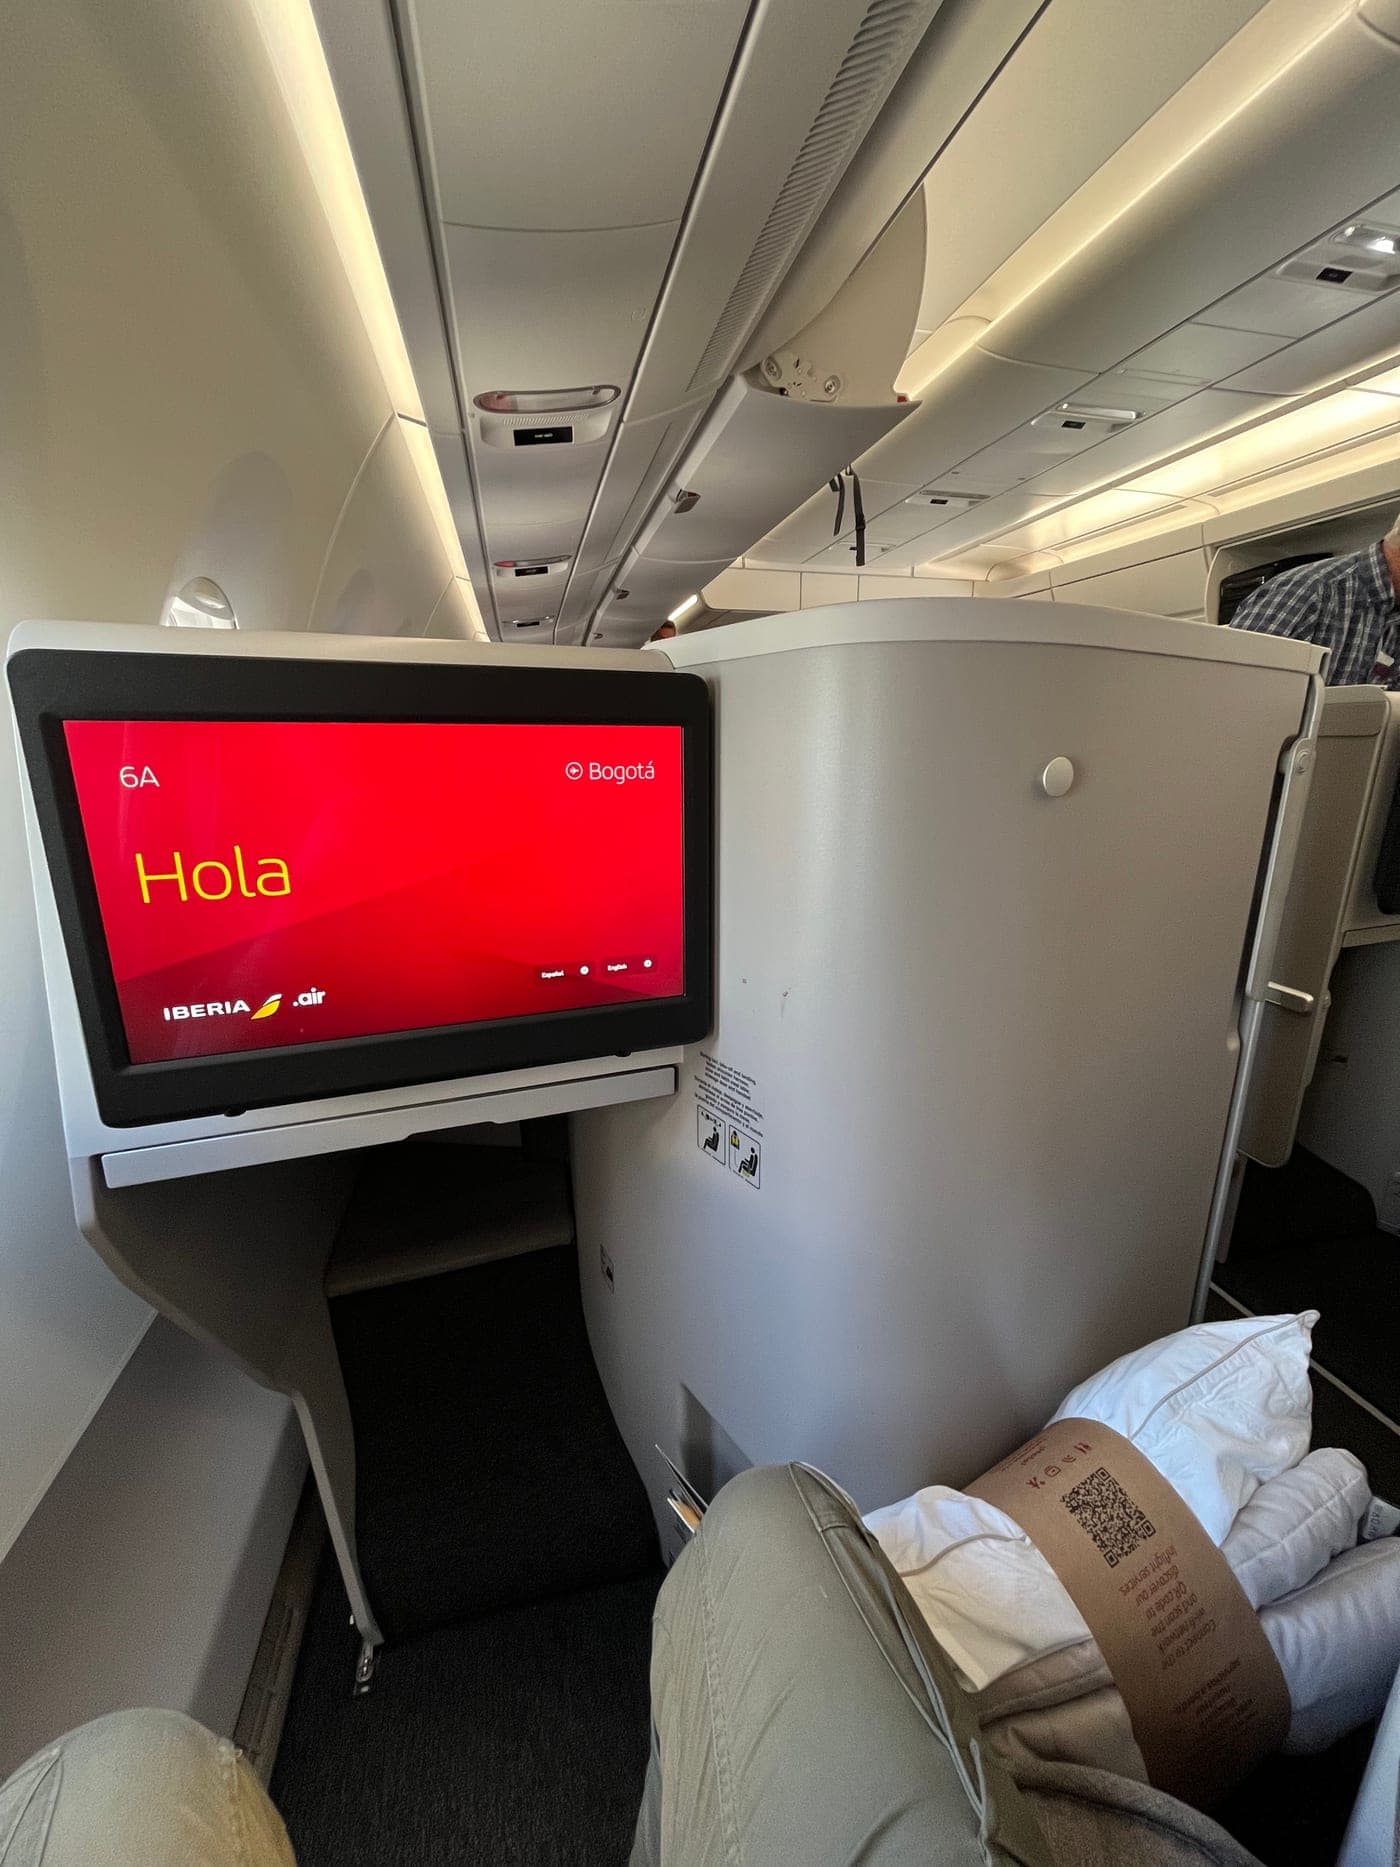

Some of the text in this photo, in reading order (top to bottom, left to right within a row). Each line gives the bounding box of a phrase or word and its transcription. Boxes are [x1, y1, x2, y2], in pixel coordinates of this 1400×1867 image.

[119, 765, 160, 789] 6A
[589, 760, 656, 786] Bogotá
[135, 845, 291, 904] Hola
[163, 987, 326, 1021] IBERIA .air
[1154, 1591, 1175, 1612] code
[1175, 1581, 1187, 1599] QR
